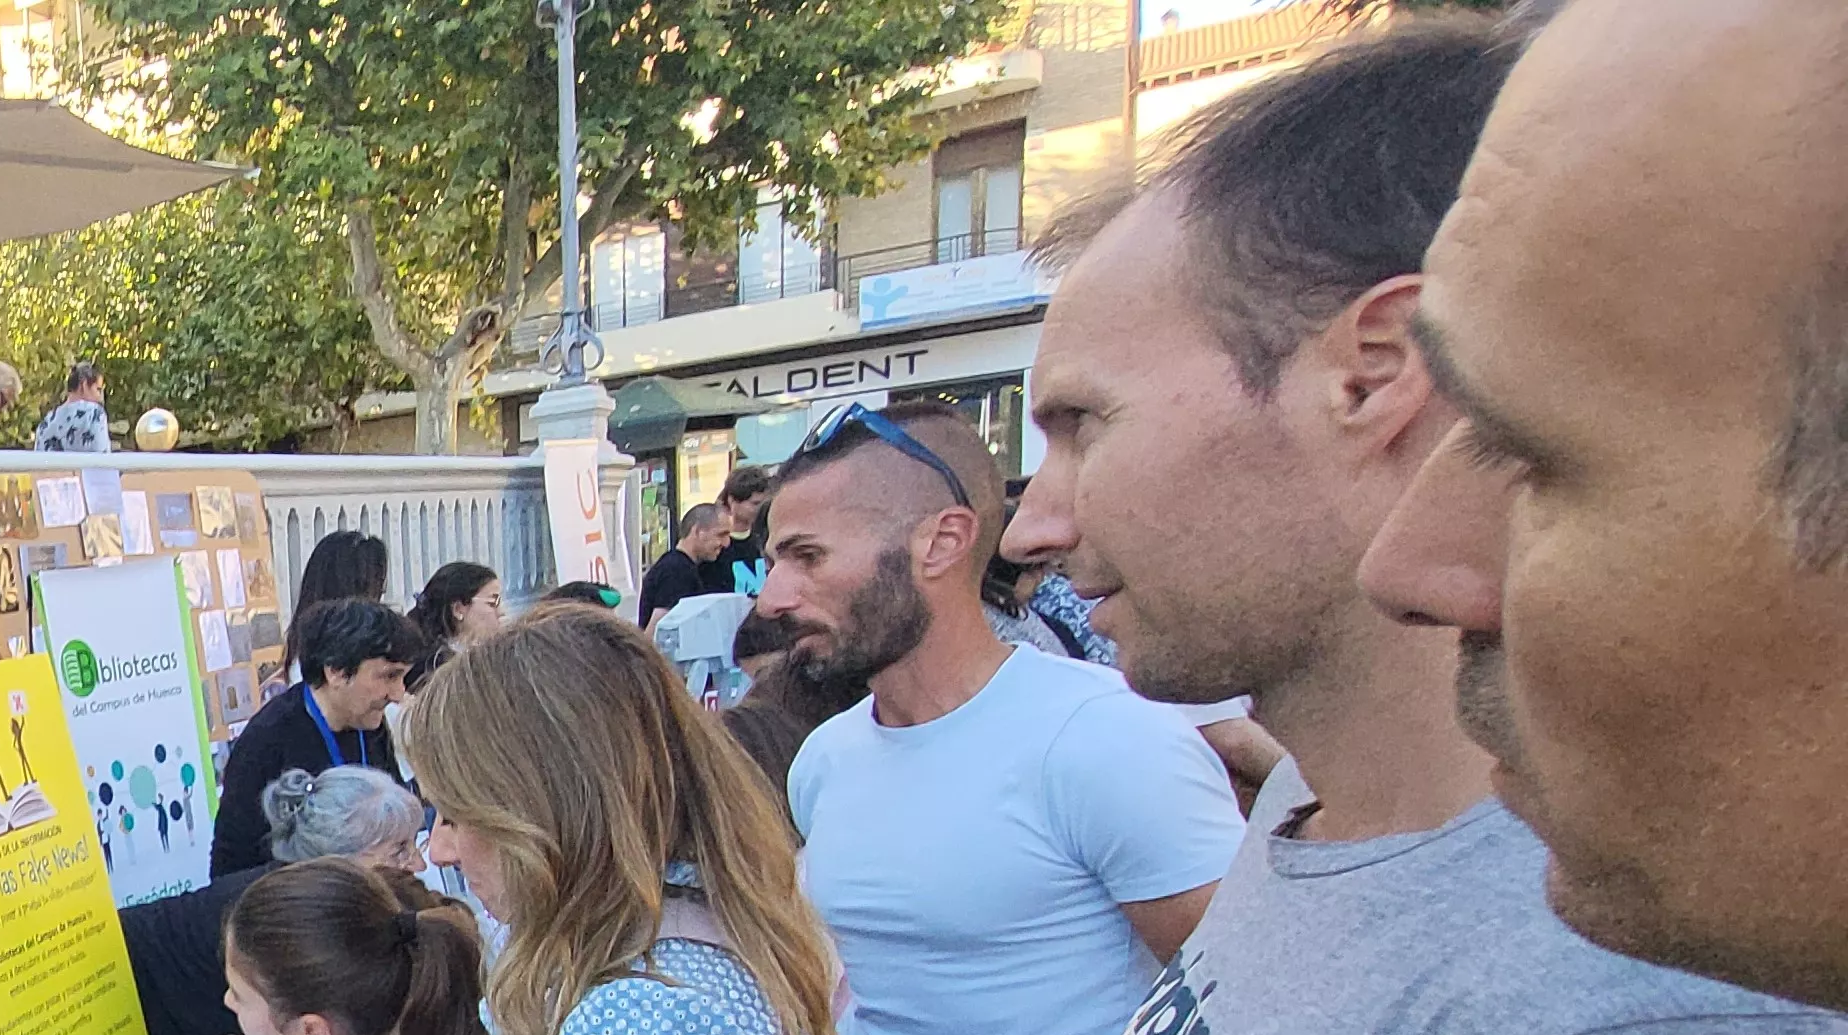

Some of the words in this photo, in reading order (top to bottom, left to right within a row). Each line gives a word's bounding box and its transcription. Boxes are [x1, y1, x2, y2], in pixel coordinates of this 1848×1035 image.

[72, 703, 88, 718] del
[89, 697, 131, 715] Campus
[132, 692, 146, 705] de
[147, 685, 183, 703] Huesca
[18, 850, 51, 888] Fake
[51, 835, 88, 870] News!
[25, 937, 34, 949] del
[35, 928, 58, 944] Campus
